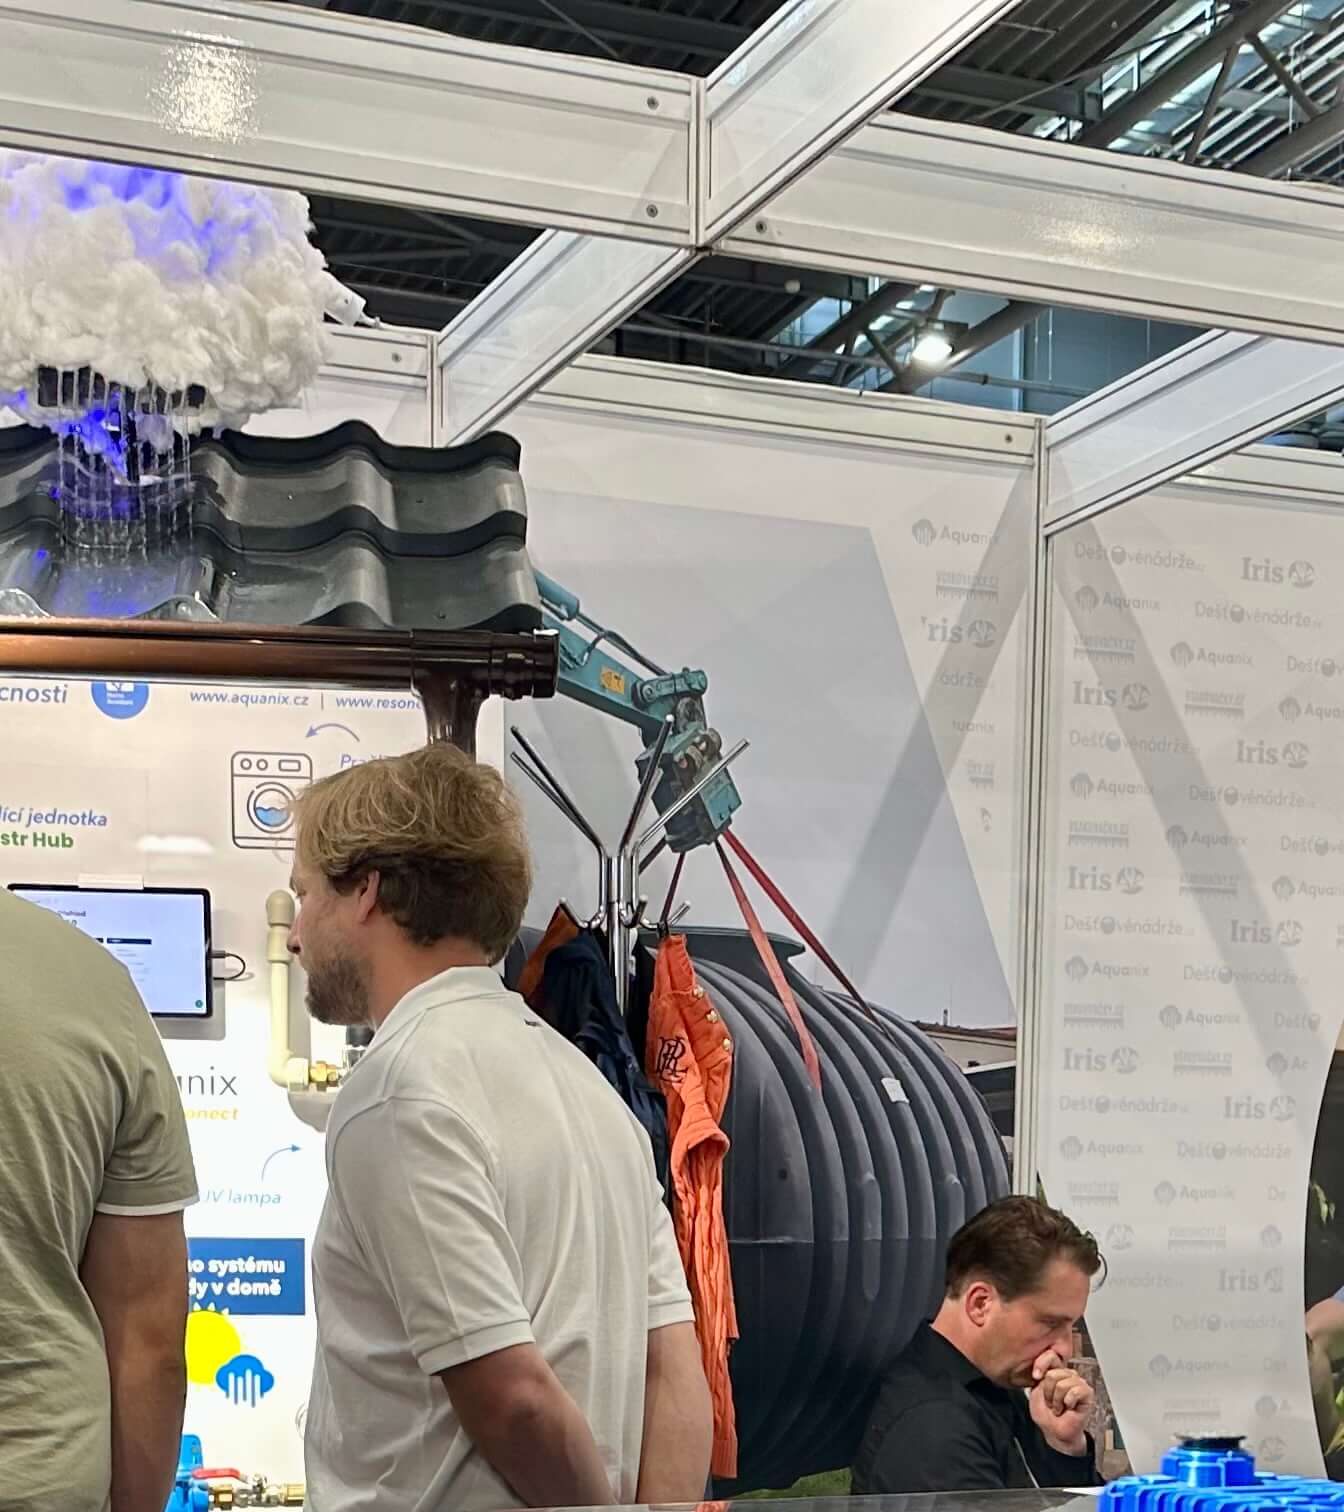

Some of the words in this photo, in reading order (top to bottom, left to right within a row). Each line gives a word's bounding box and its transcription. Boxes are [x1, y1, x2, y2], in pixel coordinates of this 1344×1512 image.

[1240, 556, 1284, 583] Iris
[190, 690, 309, 708] www.aquanix.cz
[1072, 680, 1118, 706] Iris
[1236, 739, 1279, 765] Iris
[26, 807, 108, 828] jednotka
[32, 828, 74, 849] Hub
[1067, 865, 1113, 891] Iris
[1229, 919, 1273, 945] Iris
[1062, 1046, 1107, 1072] Iris
[177, 1066, 238, 1096] nix
[185, 1108, 239, 1121] onect
[1223, 1096, 1266, 1120] Iris
[228, 1189, 282, 1208] lampa
[207, 1256, 285, 1277] systému
[211, 1280, 225, 1296] v
[227, 1277, 282, 1297] domě
[1216, 1267, 1259, 1292] Iris
